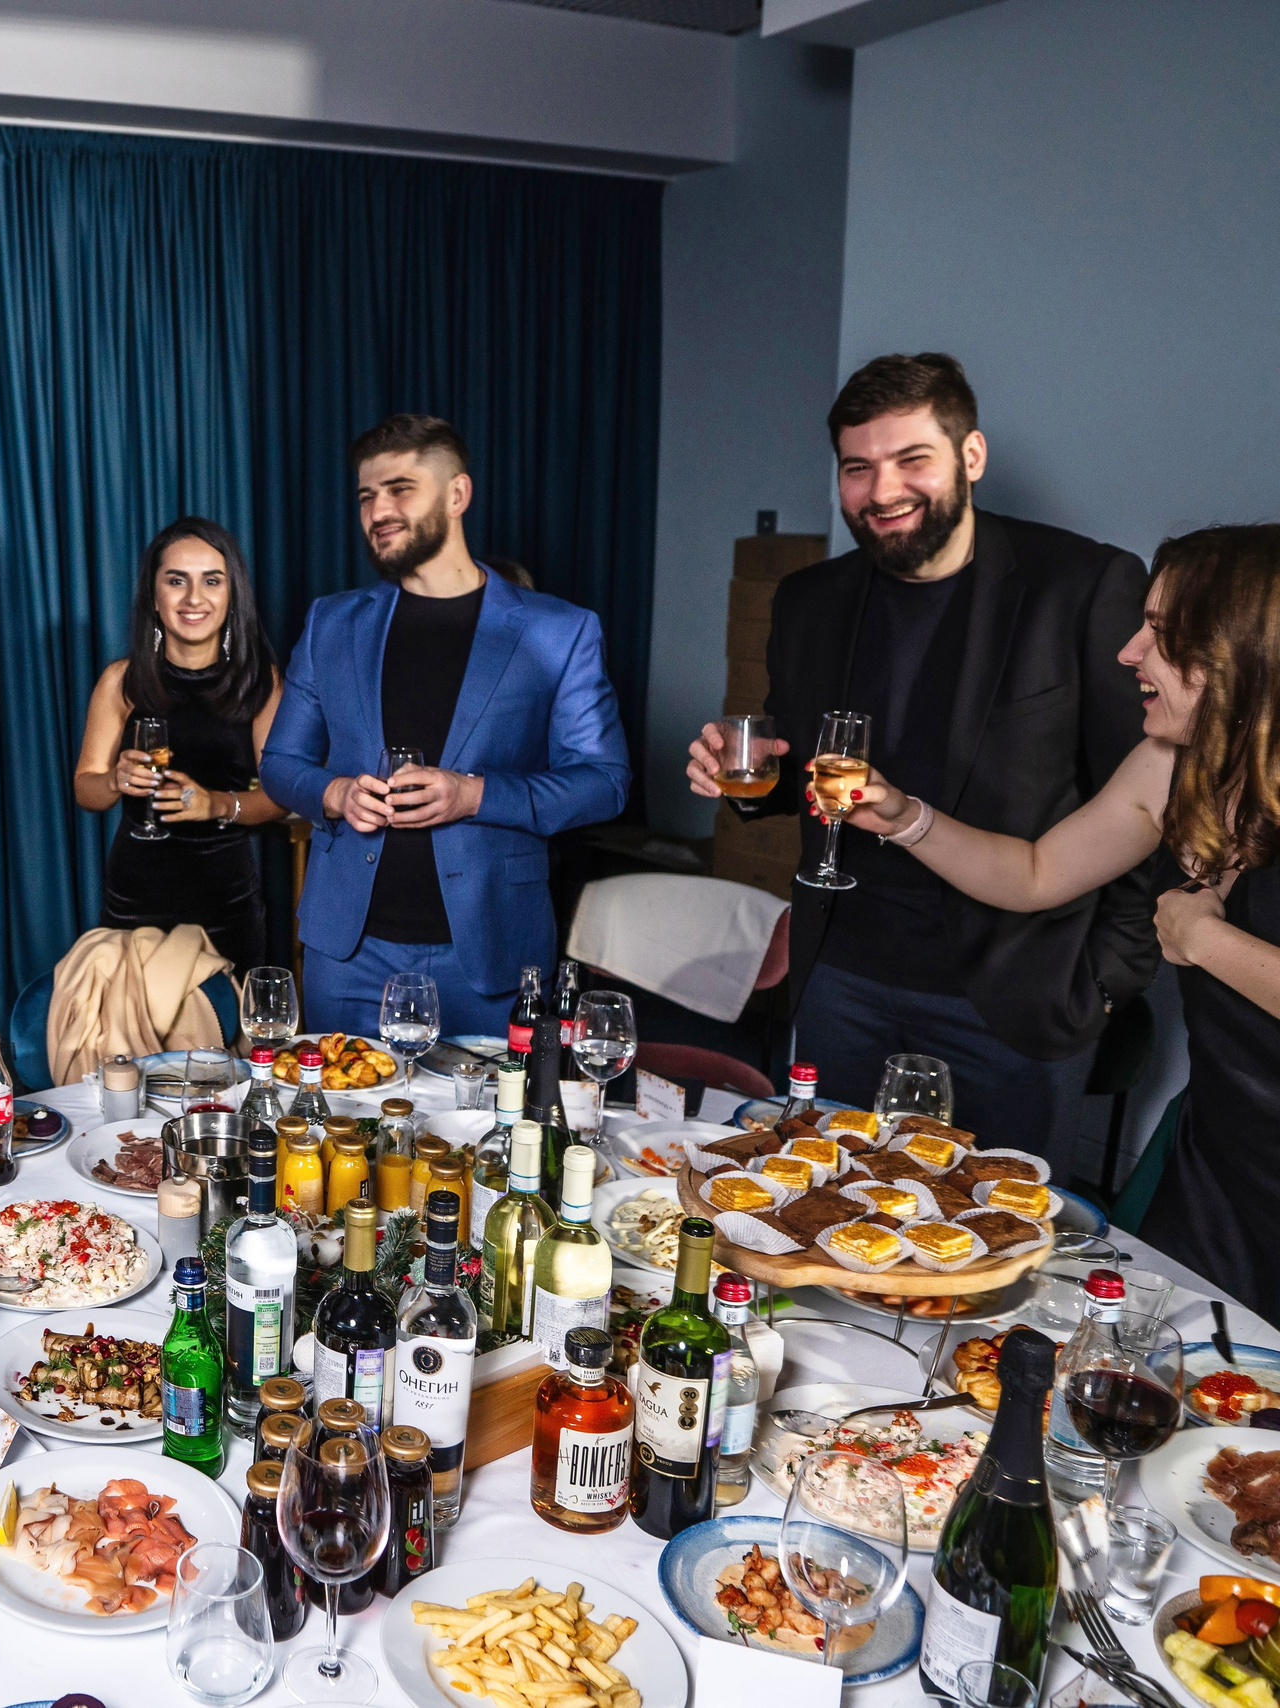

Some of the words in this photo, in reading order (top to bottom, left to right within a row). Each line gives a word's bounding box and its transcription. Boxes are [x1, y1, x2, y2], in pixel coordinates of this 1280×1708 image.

[399, 1369, 458, 1394] ОНЕГИН
[638, 1391, 669, 1418] TAGUA
[683, 1391, 696, 1400] 90
[570, 1440, 628, 1488] BONKERS
[586, 1491, 612, 1500] WHISKY
[412, 1498, 424, 1520] il
